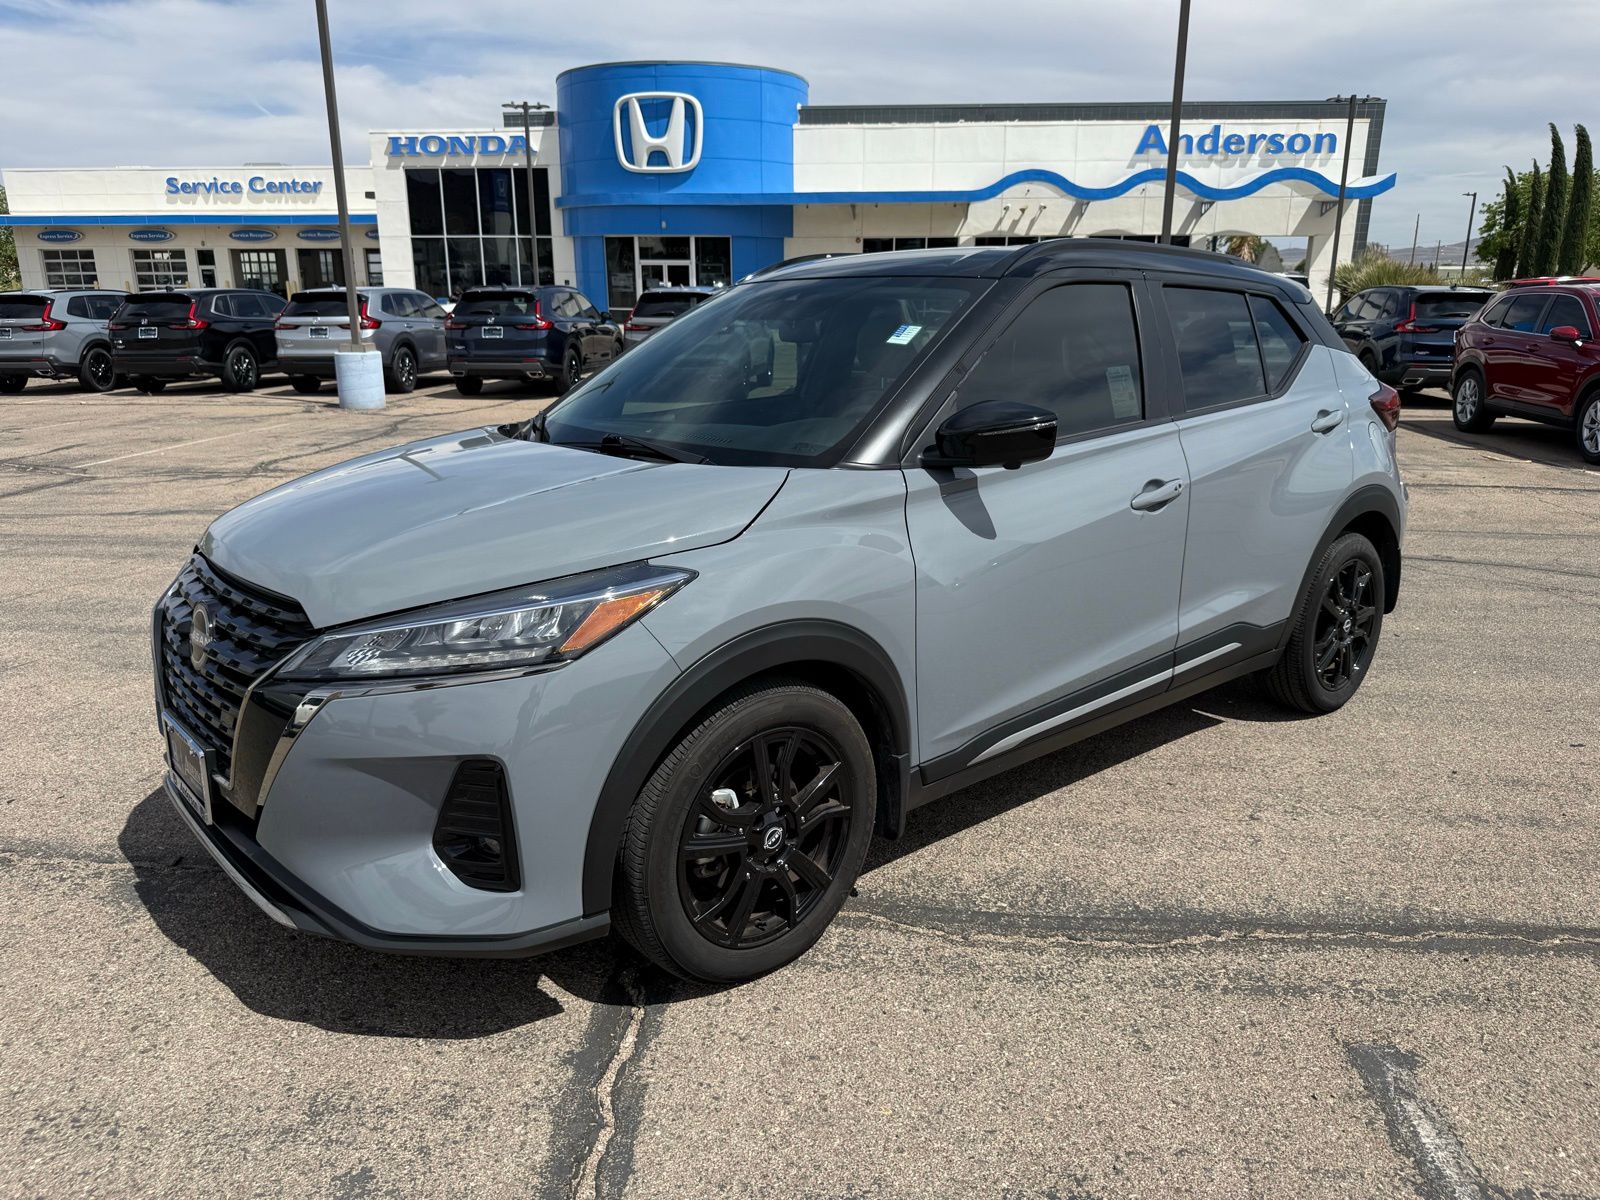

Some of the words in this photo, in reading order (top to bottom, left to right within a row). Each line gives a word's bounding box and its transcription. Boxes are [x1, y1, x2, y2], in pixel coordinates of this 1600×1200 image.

[388, 135, 538, 157] HONDA
[1135, 124, 1337, 155] Anderson
[165, 176, 243, 194] Service
[248, 176, 323, 194] Center
